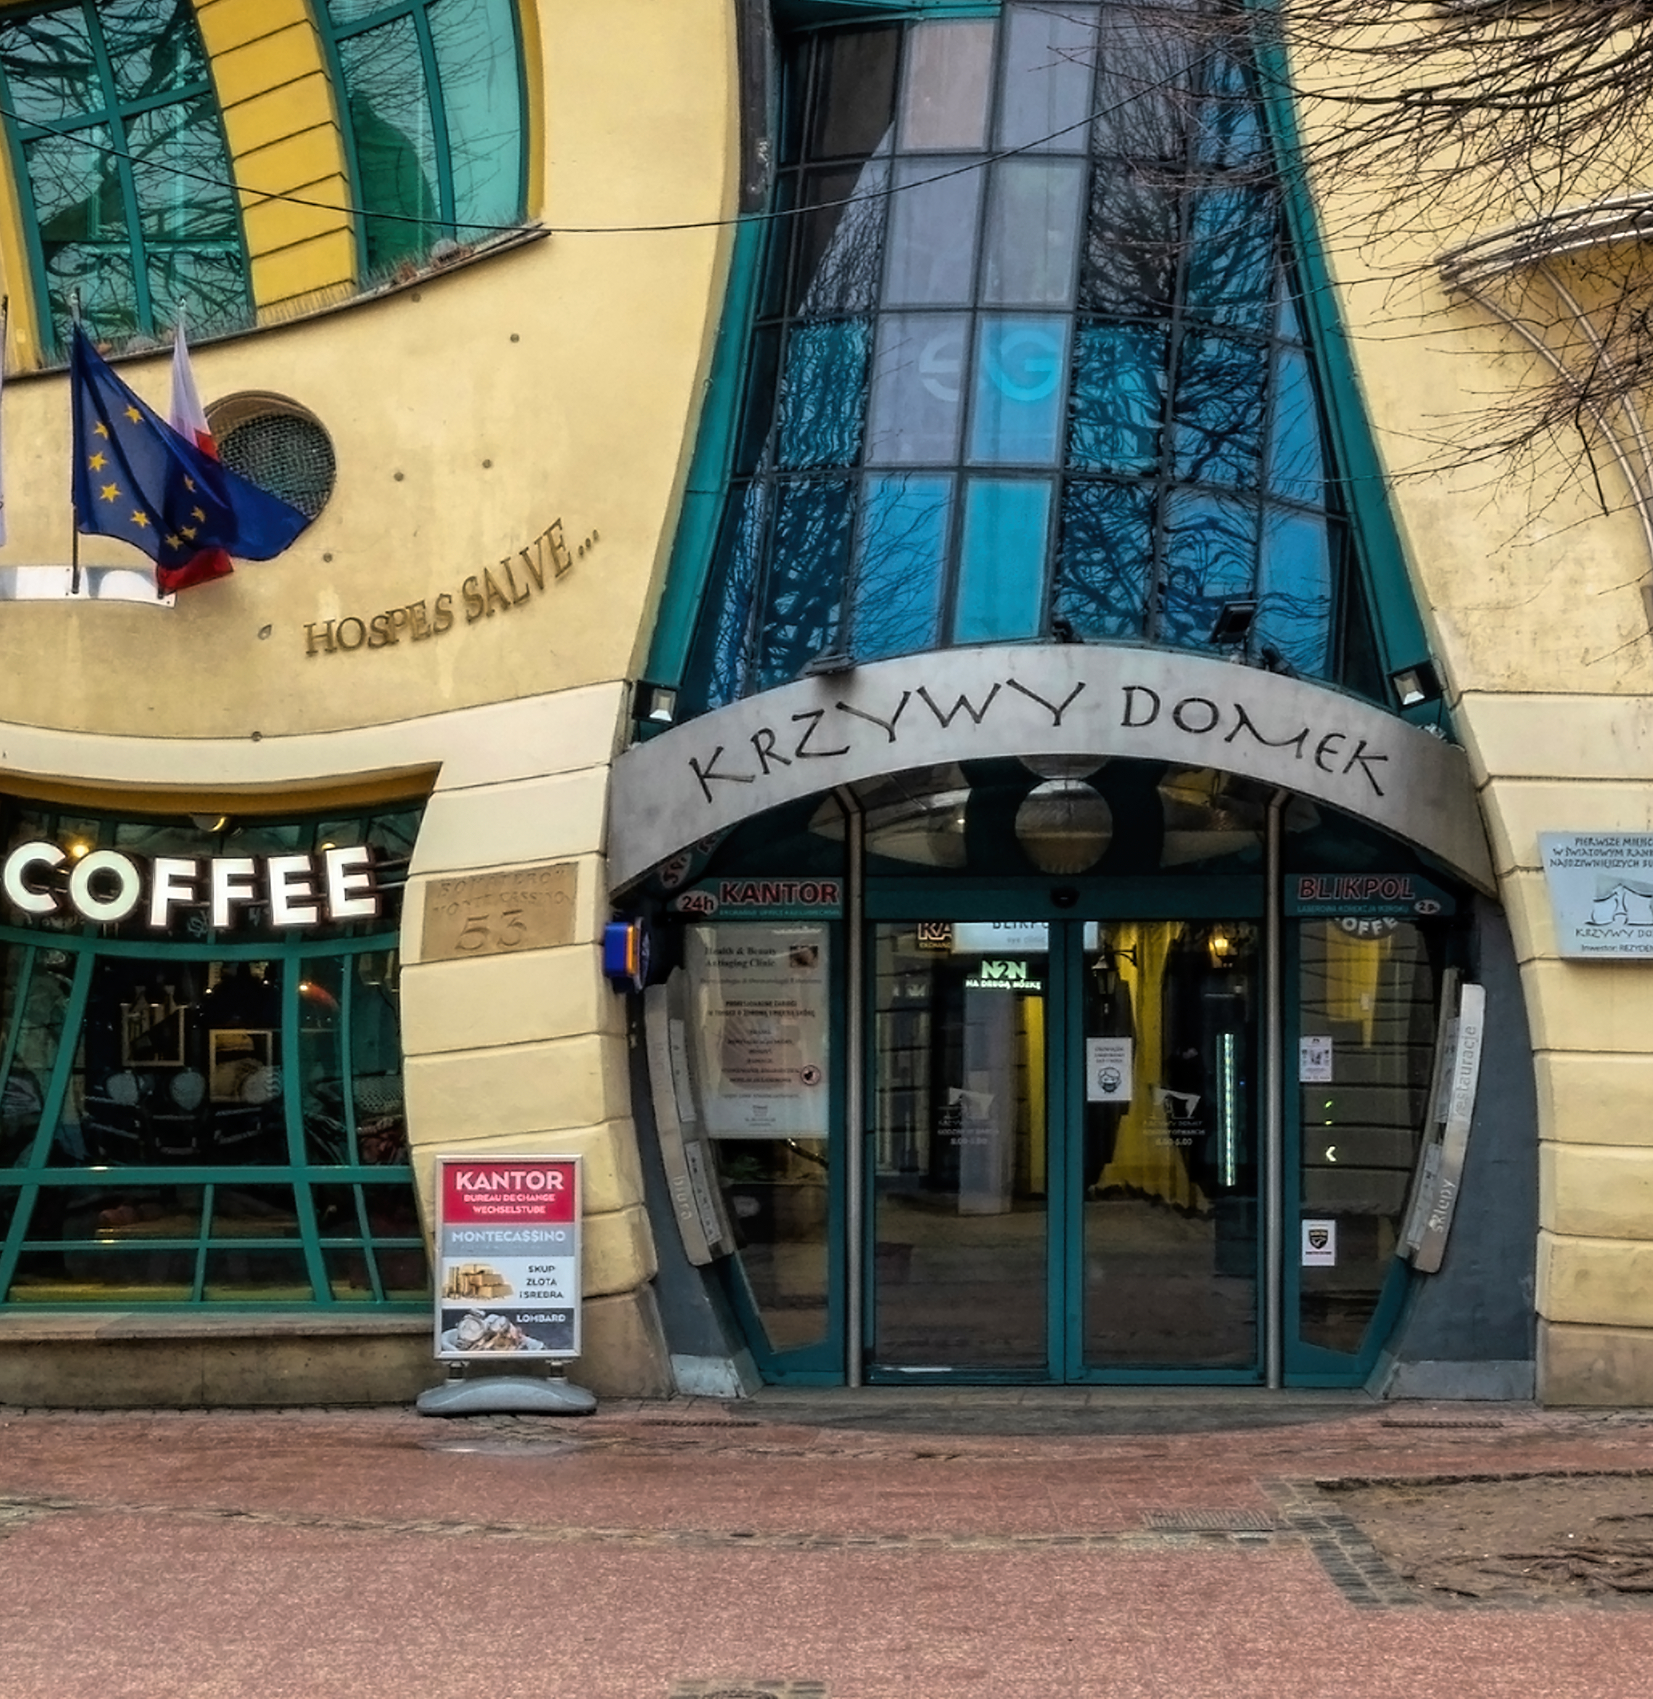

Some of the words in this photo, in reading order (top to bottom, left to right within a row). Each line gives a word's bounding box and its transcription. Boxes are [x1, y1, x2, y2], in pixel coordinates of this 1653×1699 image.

[303, 593, 453, 657] HOSPES
[462, 517, 599, 625] SALVE...
[689, 678, 1086, 802] KRZYWY
[1121, 686, 1390, 797] DOMEK
[3, 841, 376, 927] COFFEE
[720, 881, 841, 906] KANTOR
[1298, 877, 1415, 900] BLIKPOL
[681, 895, 715, 912] 24h
[455, 909, 527, 951] 53
[1575, 927, 1635, 939] KRZYWY
[981, 960, 1027, 979] N2N
[456, 1170, 564, 1190] KANTOR
[464, 1193, 502, 1202] BUREAU
[473, 1205, 547, 1214] WECHSELSTUBE
[528, 1265, 556, 1273] SKUP
[526, 1278, 558, 1286] ZŁOTA
[516, 1314, 566, 1323] LOMBARD
